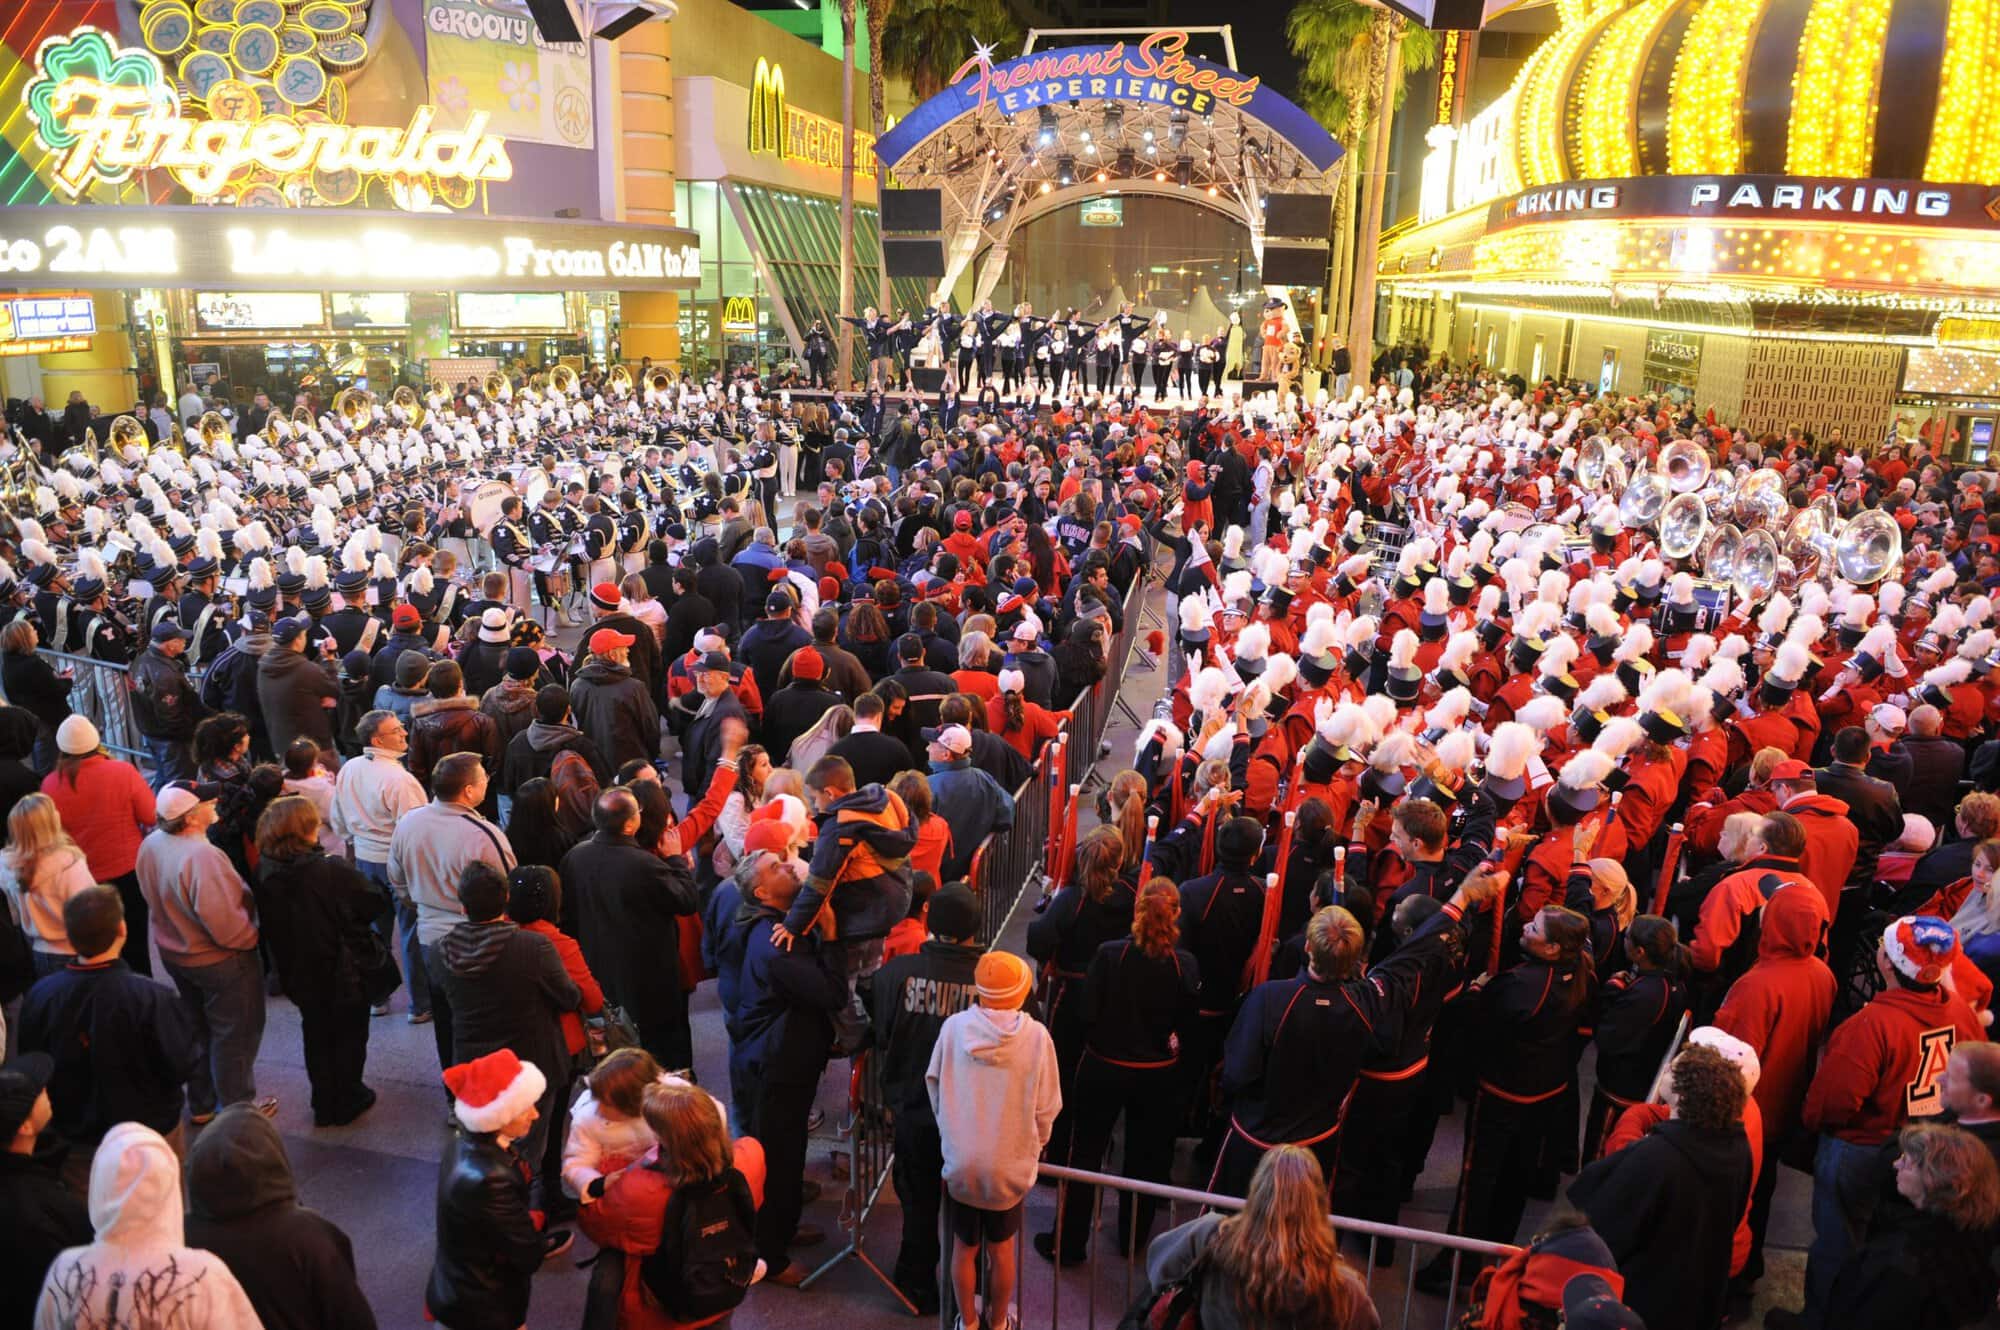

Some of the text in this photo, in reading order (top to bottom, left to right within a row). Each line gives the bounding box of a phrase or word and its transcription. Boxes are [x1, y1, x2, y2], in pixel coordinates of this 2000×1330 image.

[429, 6, 528, 45] GROOVY
[950, 30, 1259, 117] Fremont Street
[1004, 79, 1211, 113] EXPERIENCE
[1690, 183, 1952, 217] PARKING
[45, 225, 178, 272] 2AM
[504, 237, 606, 277] From
[608, 240, 664, 277] 6AM
[664, 248, 681, 277] to
[904, 976, 978, 1016] SECURIT
